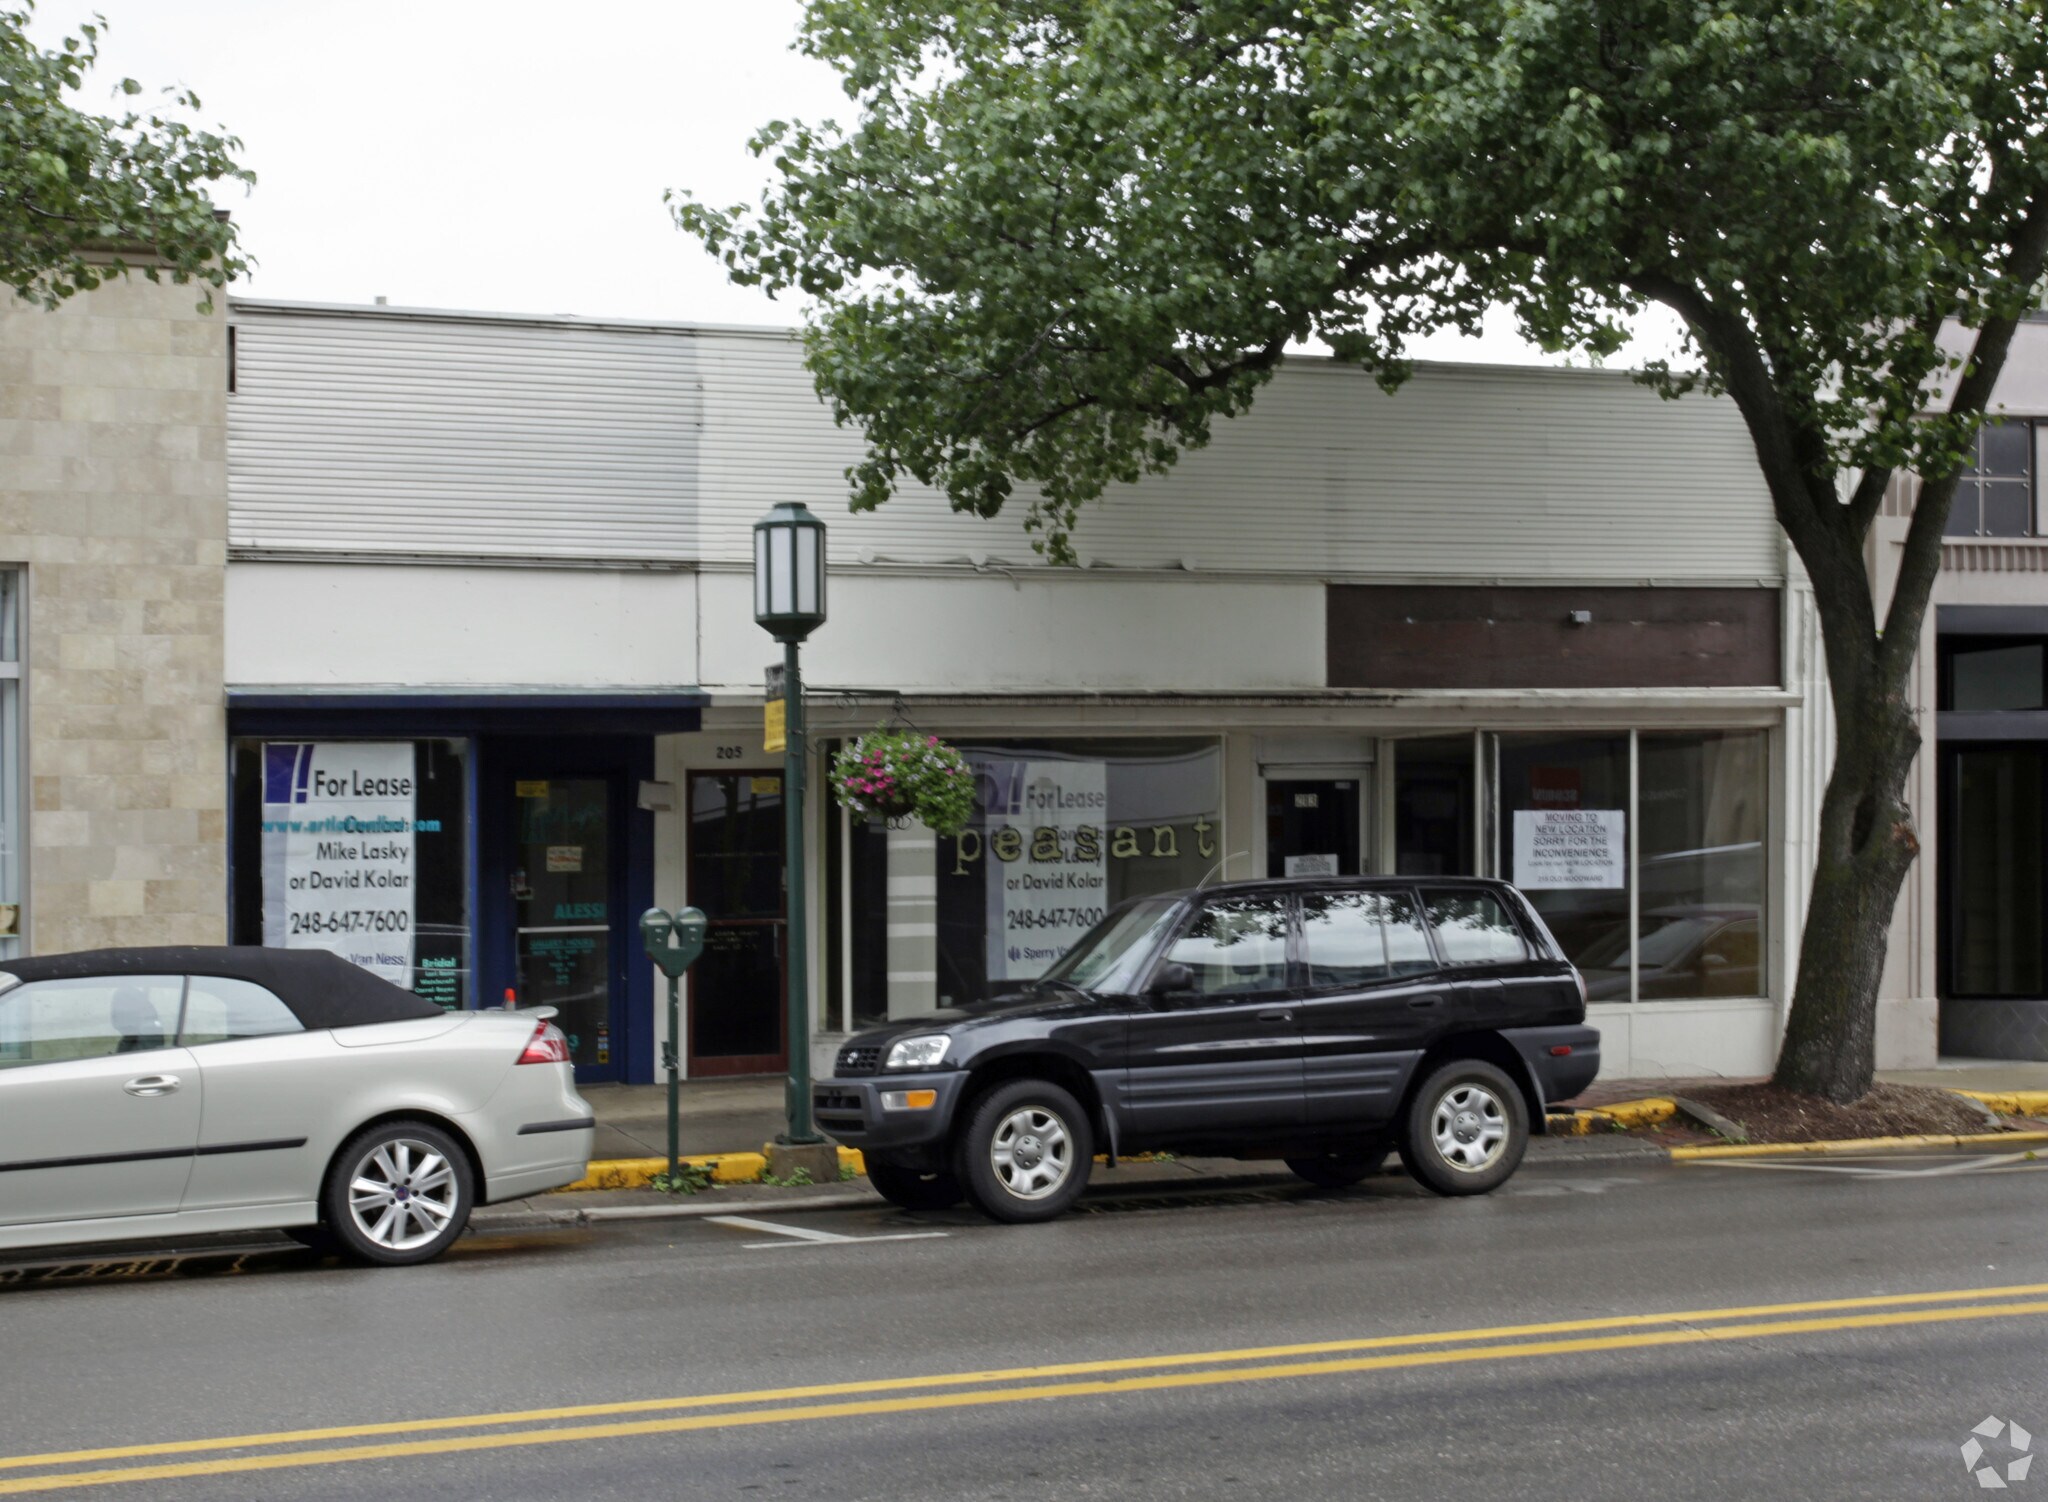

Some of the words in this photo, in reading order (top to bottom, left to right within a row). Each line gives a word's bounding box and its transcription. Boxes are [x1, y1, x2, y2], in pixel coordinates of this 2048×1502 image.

[716, 746, 742, 759] 205
[314, 770, 347, 797] For
[352, 770, 412, 797] Lease
[1027, 785, 1054, 809] For
[1057, 784, 1105, 808] Lease
[1545, 813, 1582, 821] MOVING
[1584, 813, 1597, 821] TO
[1535, 825, 1556, 834] NEW
[1558, 825, 1606, 834] LOCATION
[952, 816, 1215, 876] peasant
[1533, 837, 1564, 846] SORRY
[1567, 837, 1588, 846] FOR
[1590, 837, 1607, 846] THE
[316, 844, 357, 861] Mike
[361, 842, 408, 863] Lasky
[1533, 849, 1608, 857] INCONVENIENCE
[290, 876, 306, 890] or
[309, 871, 359, 890] David
[363, 871, 409, 889] Kolar
[1007, 879, 1019, 890] or
[1023, 873, 1063, 890] David
[1066, 871, 1103, 889] Kolar
[290, 910, 408, 935] 248-647-7600
[1007, 907, 1103, 930] 248-647-7600
[1023, 947, 1055, 960] Sperry
